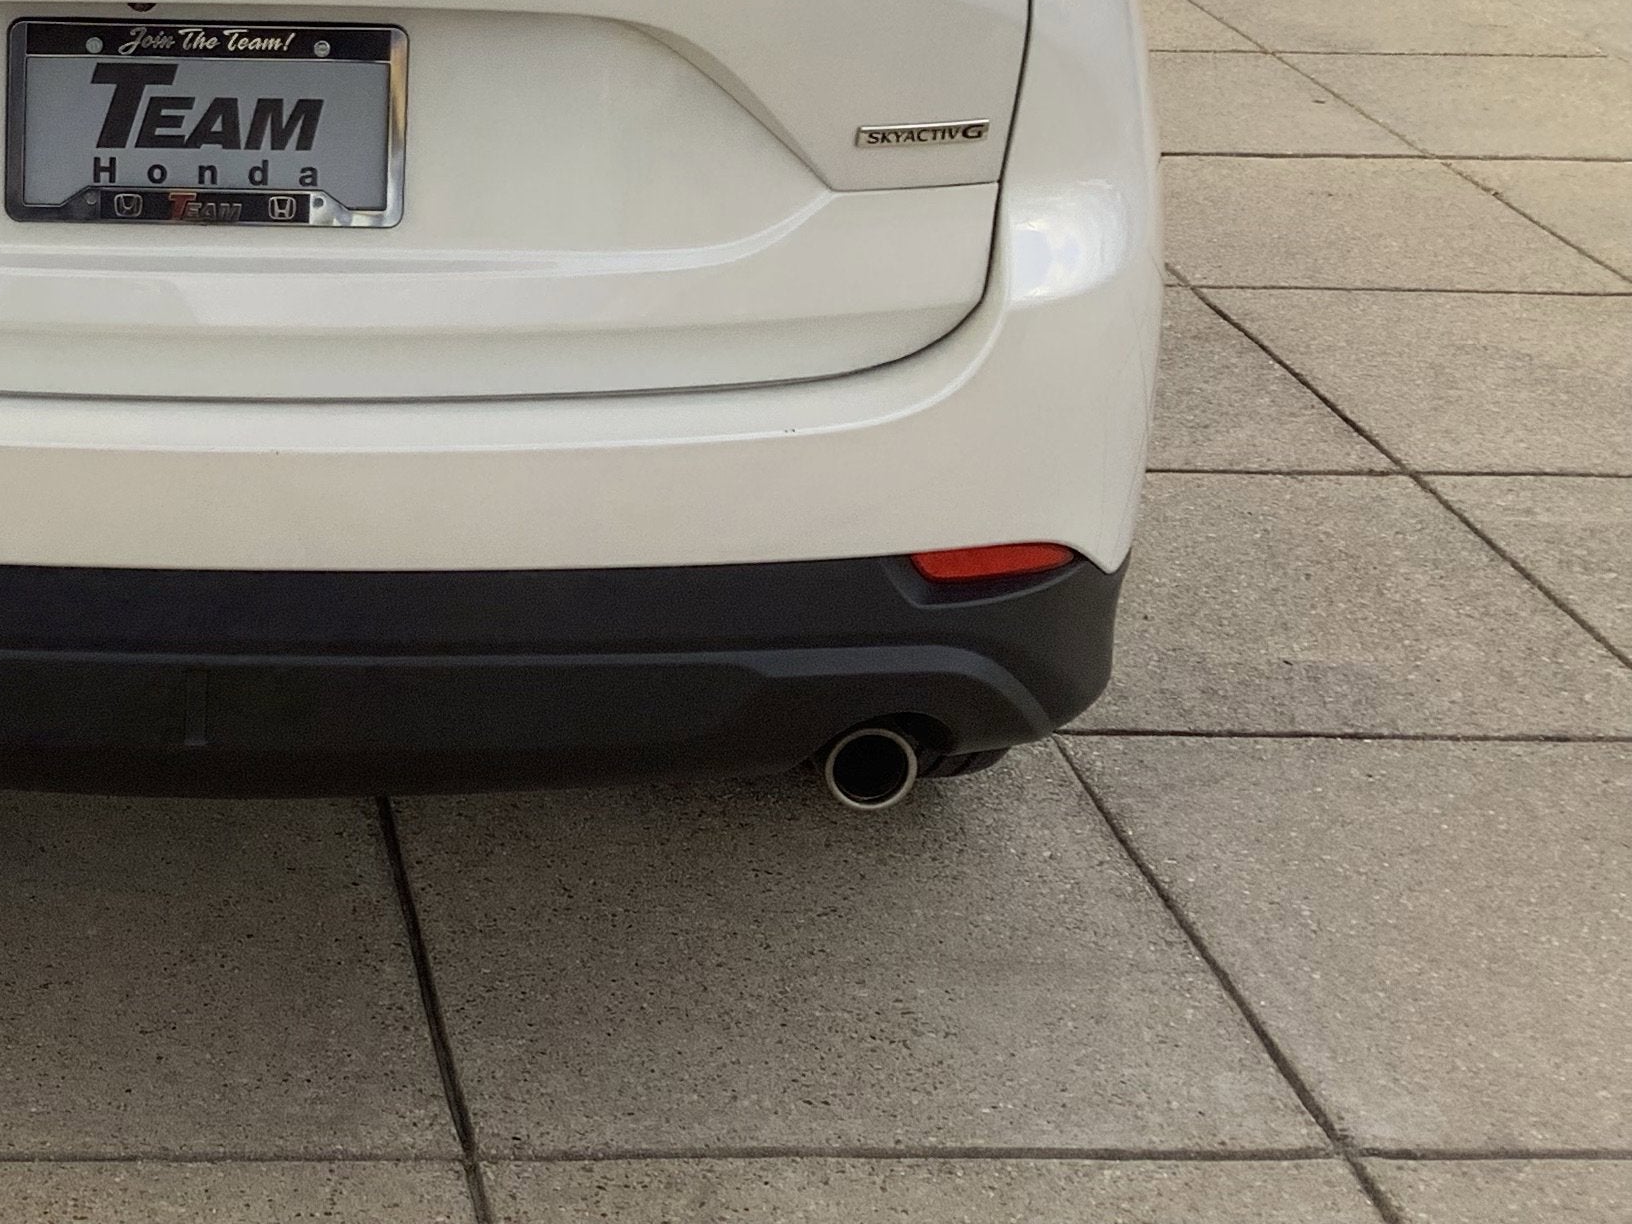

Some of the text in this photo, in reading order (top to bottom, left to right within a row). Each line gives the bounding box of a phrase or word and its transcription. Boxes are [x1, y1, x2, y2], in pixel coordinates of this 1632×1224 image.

[118, 26, 296, 55] Join The Team!
[91, 62, 324, 151] TEAM
[92, 157, 319, 187] Honda
[169, 192, 242, 221] TEAM
